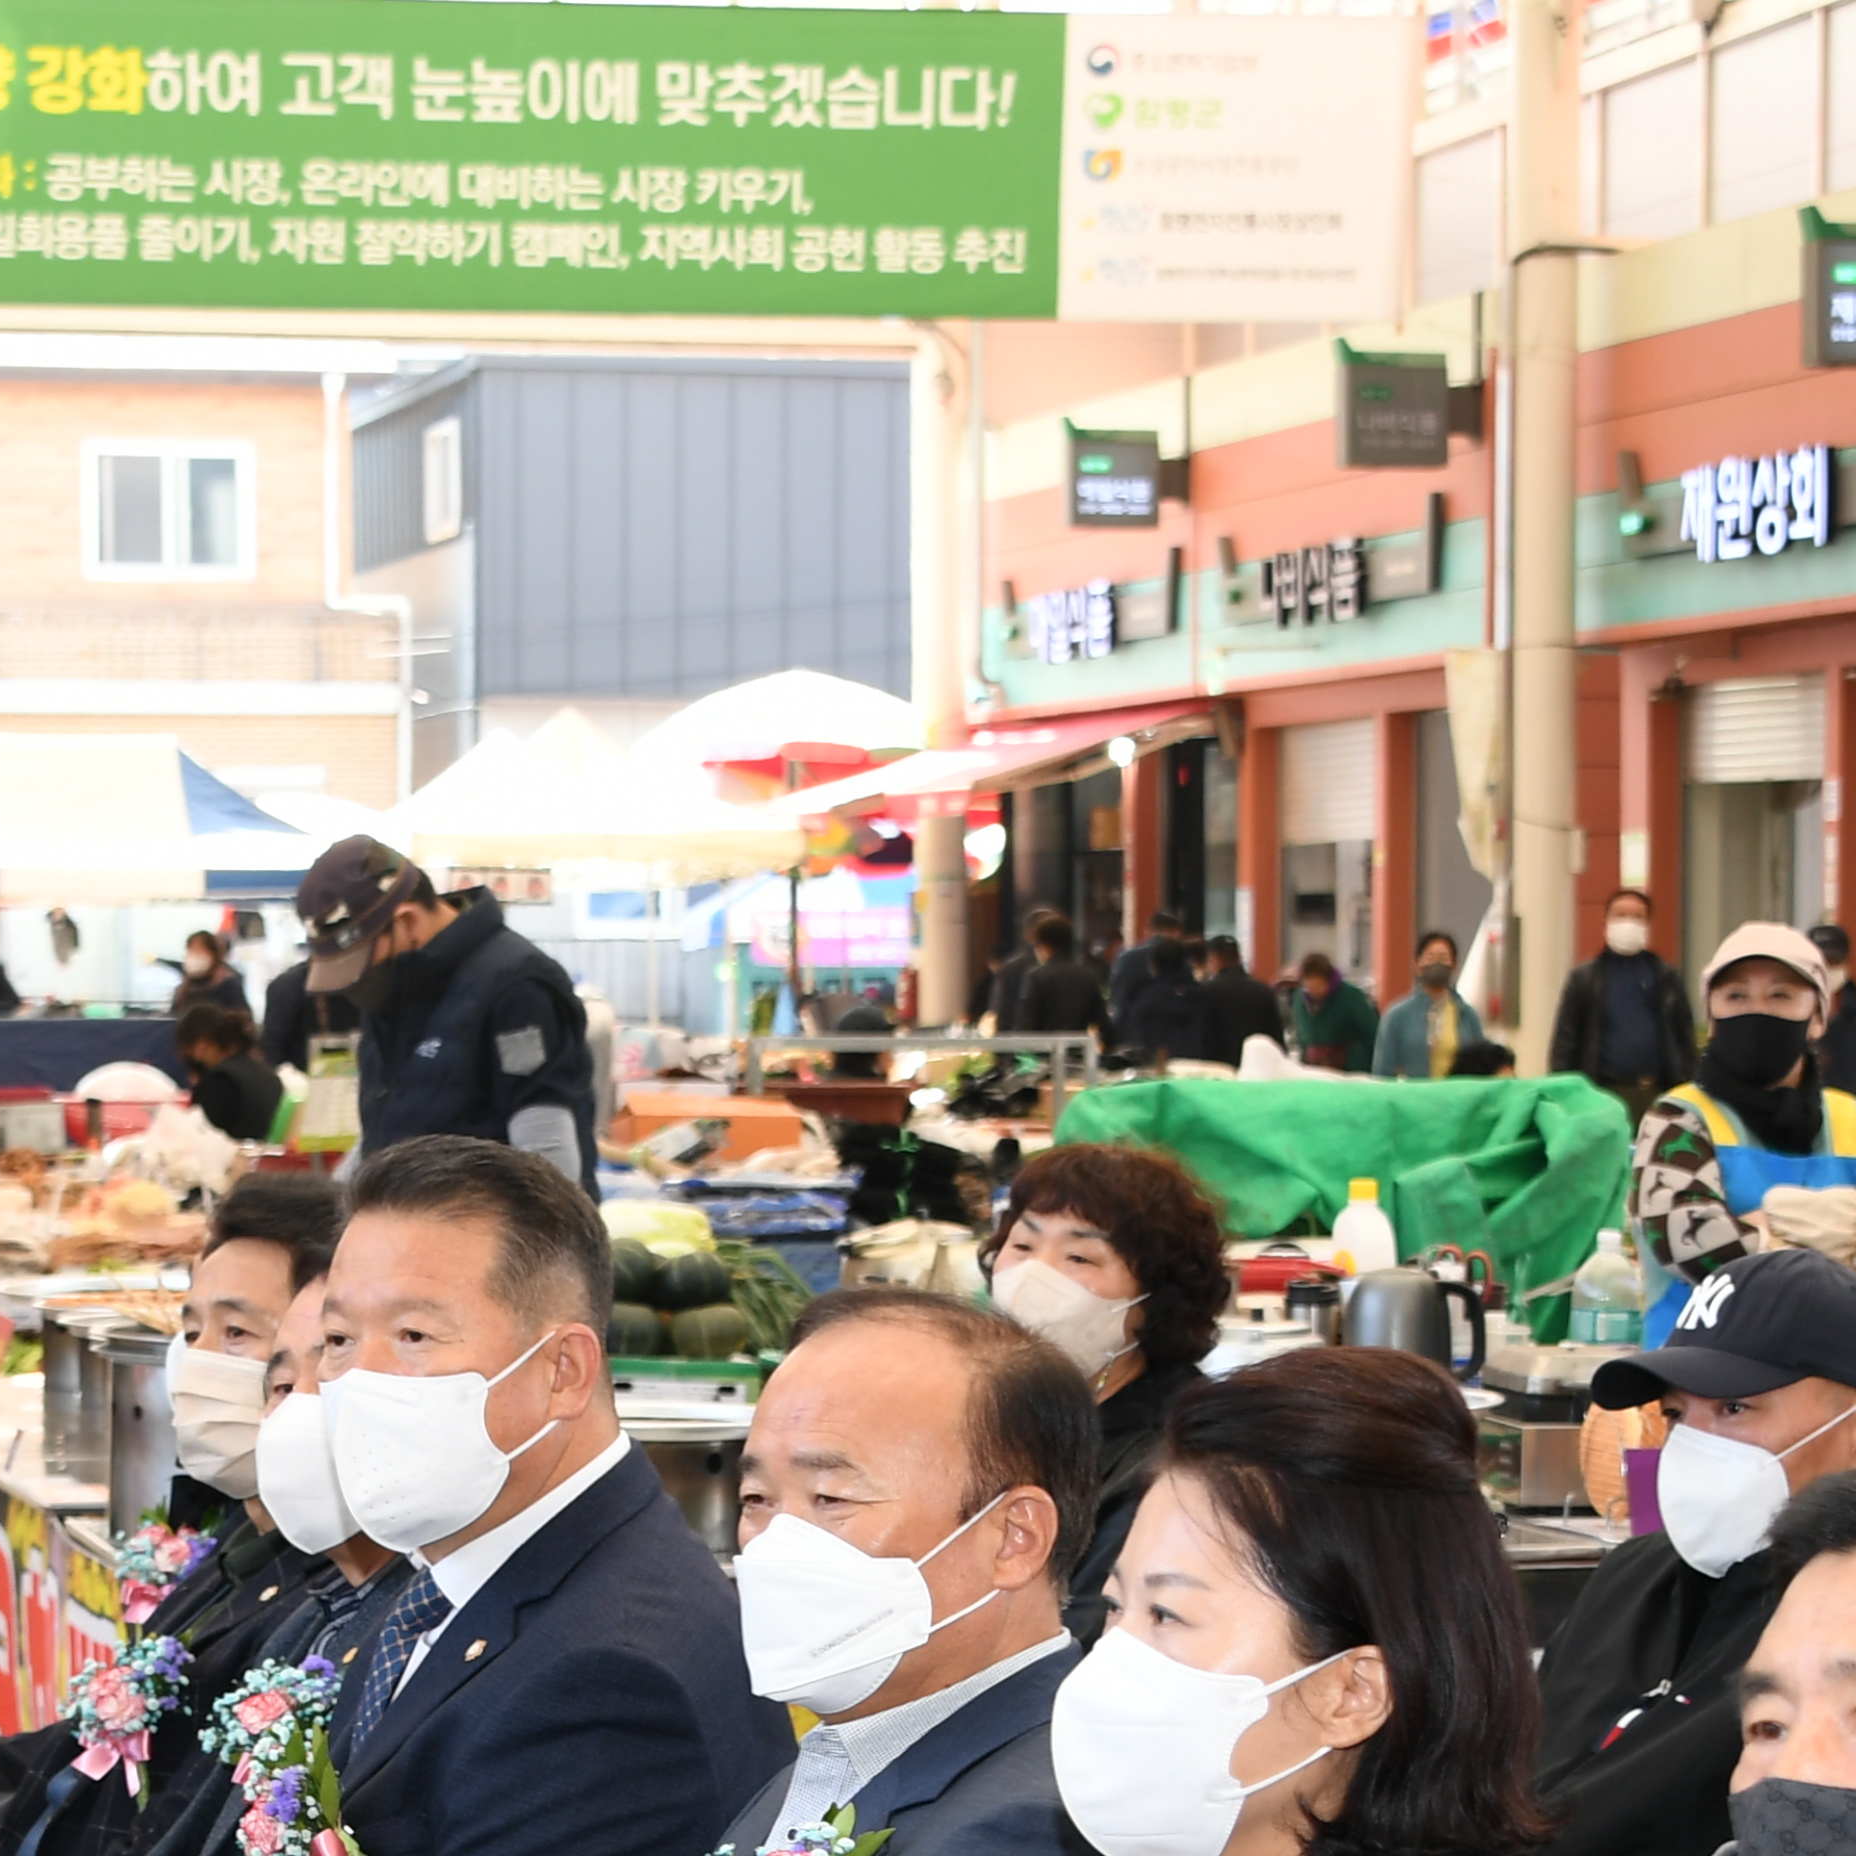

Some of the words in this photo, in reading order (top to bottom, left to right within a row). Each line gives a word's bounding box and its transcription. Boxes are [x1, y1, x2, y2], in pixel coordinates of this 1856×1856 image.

[26, 46, 263, 117] 강화하여
[279, 50, 394, 120] 고객
[411, 56, 640, 124] 눈높이에
[656, 59, 1018, 130] 맞추겠습니다!
[45, 153, 197, 203] 공부하는
[204, 157, 291, 207] 시장,
[300, 160, 449, 208] 온라인에
[458, 164, 603, 210] 대비하는
[611, 166, 687, 214] 시장
[695, 166, 813, 216] 키우기,
[137, 215, 262, 264] 줄이기,
[269, 217, 346, 265] 자원
[354, 219, 502, 267] 절약하기
[510, 222, 631, 271] 캠페인,
[639, 224, 784, 272] 지역사회
[791, 226, 865, 273] 공헌
[873, 228, 943, 275] 활동
[952, 228, 1028, 275] 추진
[1679, 442, 1830, 563] 재원상회
